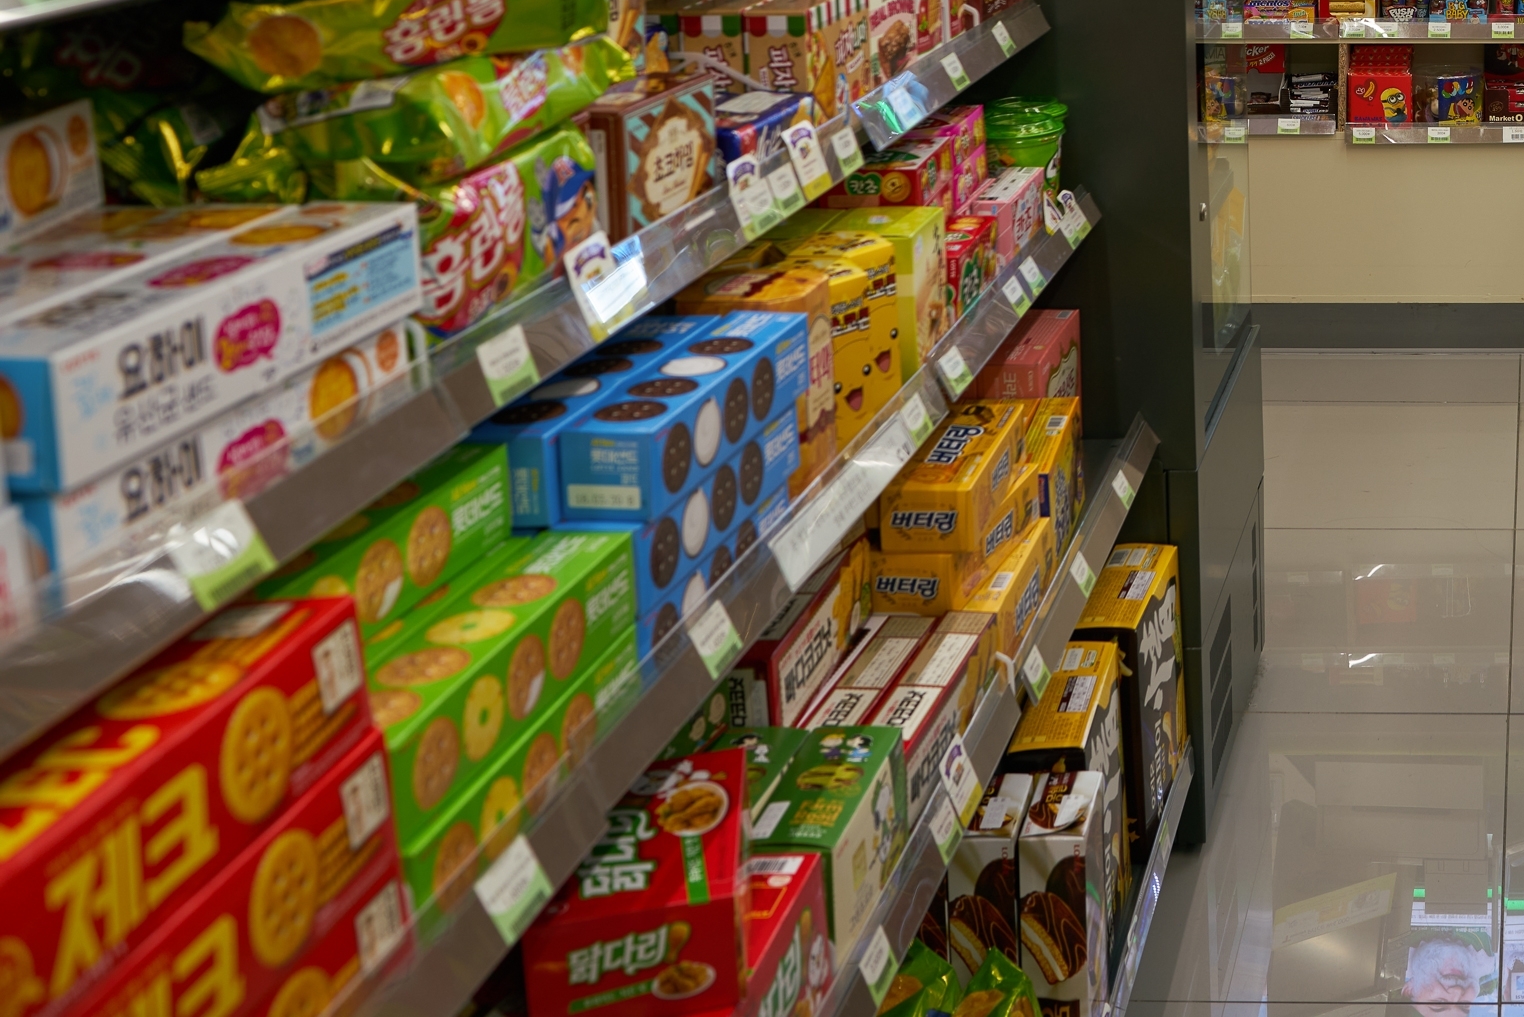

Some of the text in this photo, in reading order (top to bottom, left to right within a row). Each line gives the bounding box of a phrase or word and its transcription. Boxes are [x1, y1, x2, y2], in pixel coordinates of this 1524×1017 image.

[1250, 0, 1290, 8] mentos
[1389, 7, 1415, 16] PUSH
[1446, 9, 1469, 20] BABY
[1515, 113, 1523, 122] O
[926, 424, 985, 465] 버터링
[891, 510, 957, 533] 버터링
[984, 507, 1015, 557] 버터링
[875, 575, 940, 599] 버터링
[46, 763, 219, 998] 제크
[567, 923, 669, 986] 닭다리
